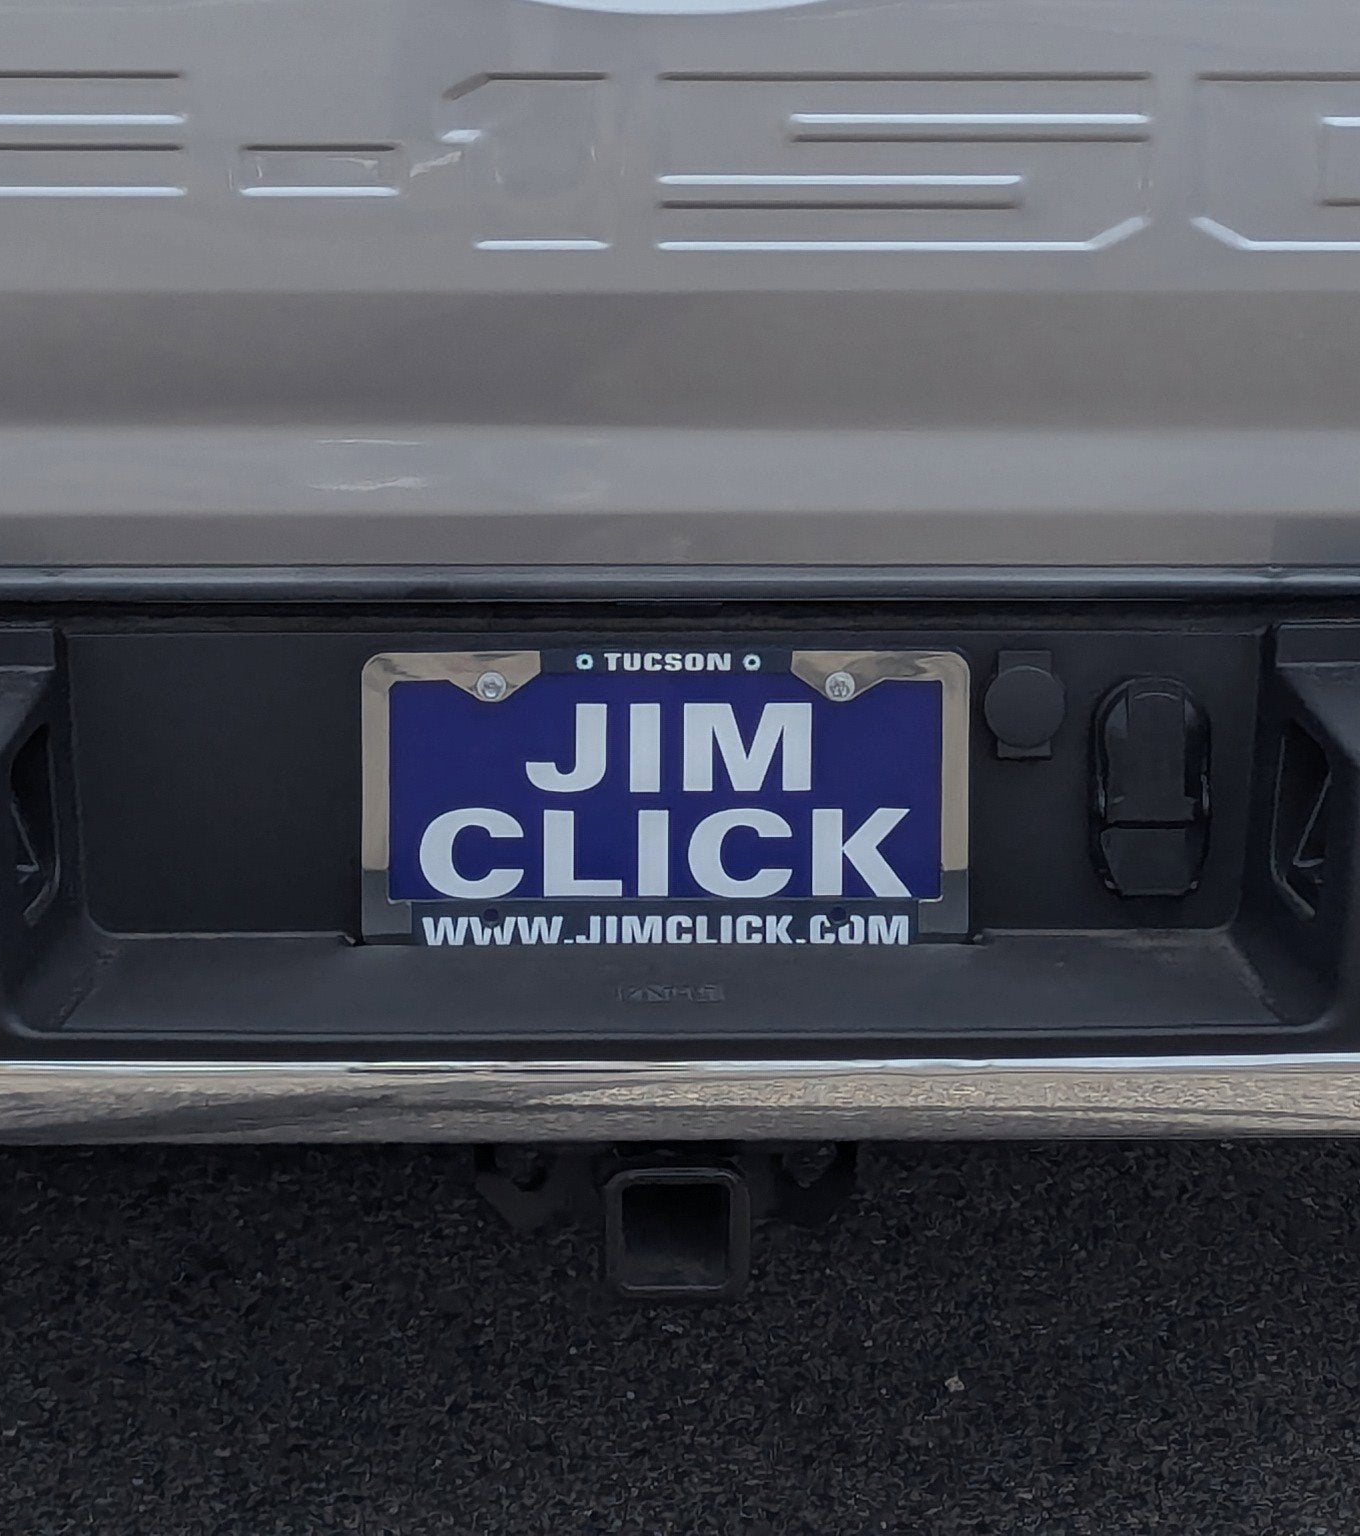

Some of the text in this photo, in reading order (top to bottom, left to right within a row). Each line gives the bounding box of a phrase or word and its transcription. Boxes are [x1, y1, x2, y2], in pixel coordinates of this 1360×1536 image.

[604, 652, 732, 672] TUCSON
[525, 702, 814, 793] JIM
[418, 807, 912, 899] CLICK
[422, 914, 910, 946] WWW.JIMCLICK.COM
